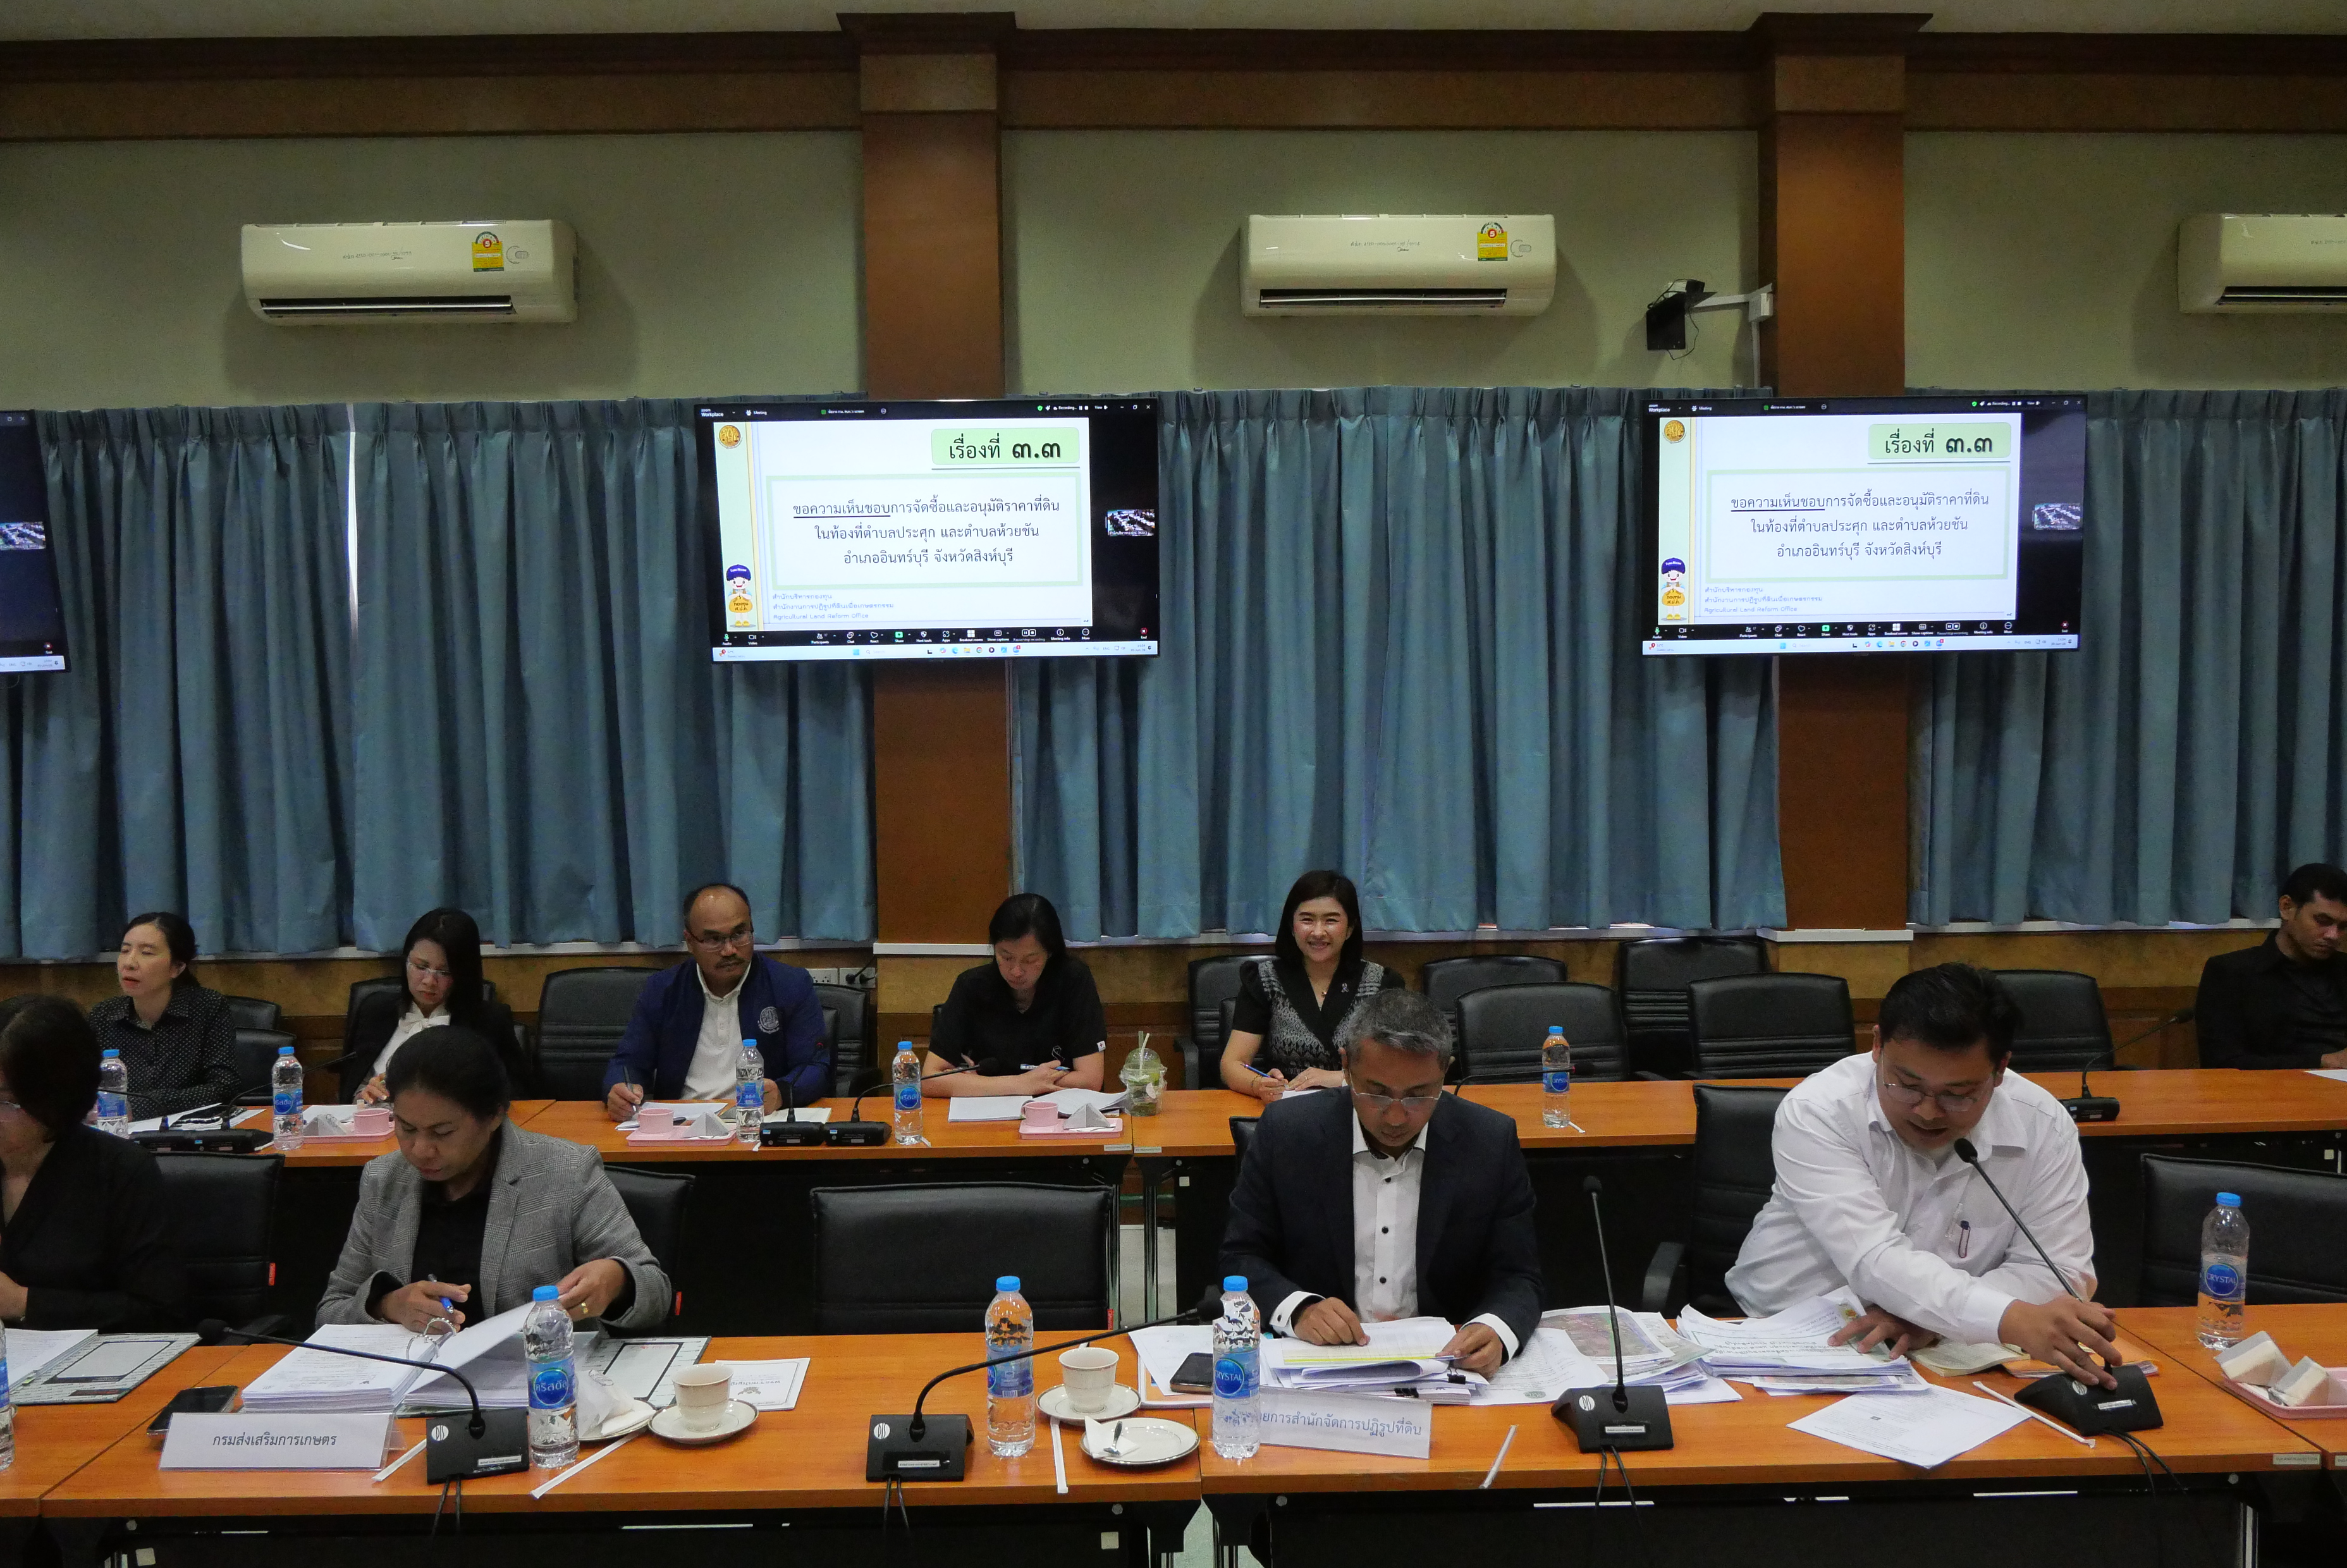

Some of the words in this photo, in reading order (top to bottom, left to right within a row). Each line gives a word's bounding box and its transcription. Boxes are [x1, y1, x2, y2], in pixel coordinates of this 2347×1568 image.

[949, 432, 1001, 460] เรื่องที่
[1012, 442, 1061, 459] ๓.๓
[1885, 427, 1935, 454] เรื่องที่
[1946, 438, 1992, 453] ๓.๓
[793, 494, 1060, 516] ขอความเห็นชอบการจัดซื้อและอนุมัติราคาที่ดิน
[1731, 488, 1989, 510] ขอความเห็นชอบการจัดซื้อและอนุมัติราคาที่ดิน
[814, 524, 935, 542] ในท้องที่ตำบลประศุก
[941, 524, 1039, 539] และตำบลห้วยชัน
[1751, 517, 1867, 536] ในท้องที่ตำบลประศุก
[1873, 517, 1968, 532] และตำบลห้วยชัน
[843, 548, 929, 567] อำเภออินทร์บุรี
[934, 548, 1013, 567] จังหวัดสิงห์บุรี
[1777, 542, 1860, 560] อำเภออินทร์บุรี
[1865, 541, 1942, 560] จังหวัดสิงห์บุรี
[2207, 1273, 2236, 1283] CRYSTAL
[1239, 1411, 1422, 1436] ยการสำนักจัดการปฏิรูปที่ดิน
[212, 1430, 337, 1447] กรมส่งเสริมการเกษตร
